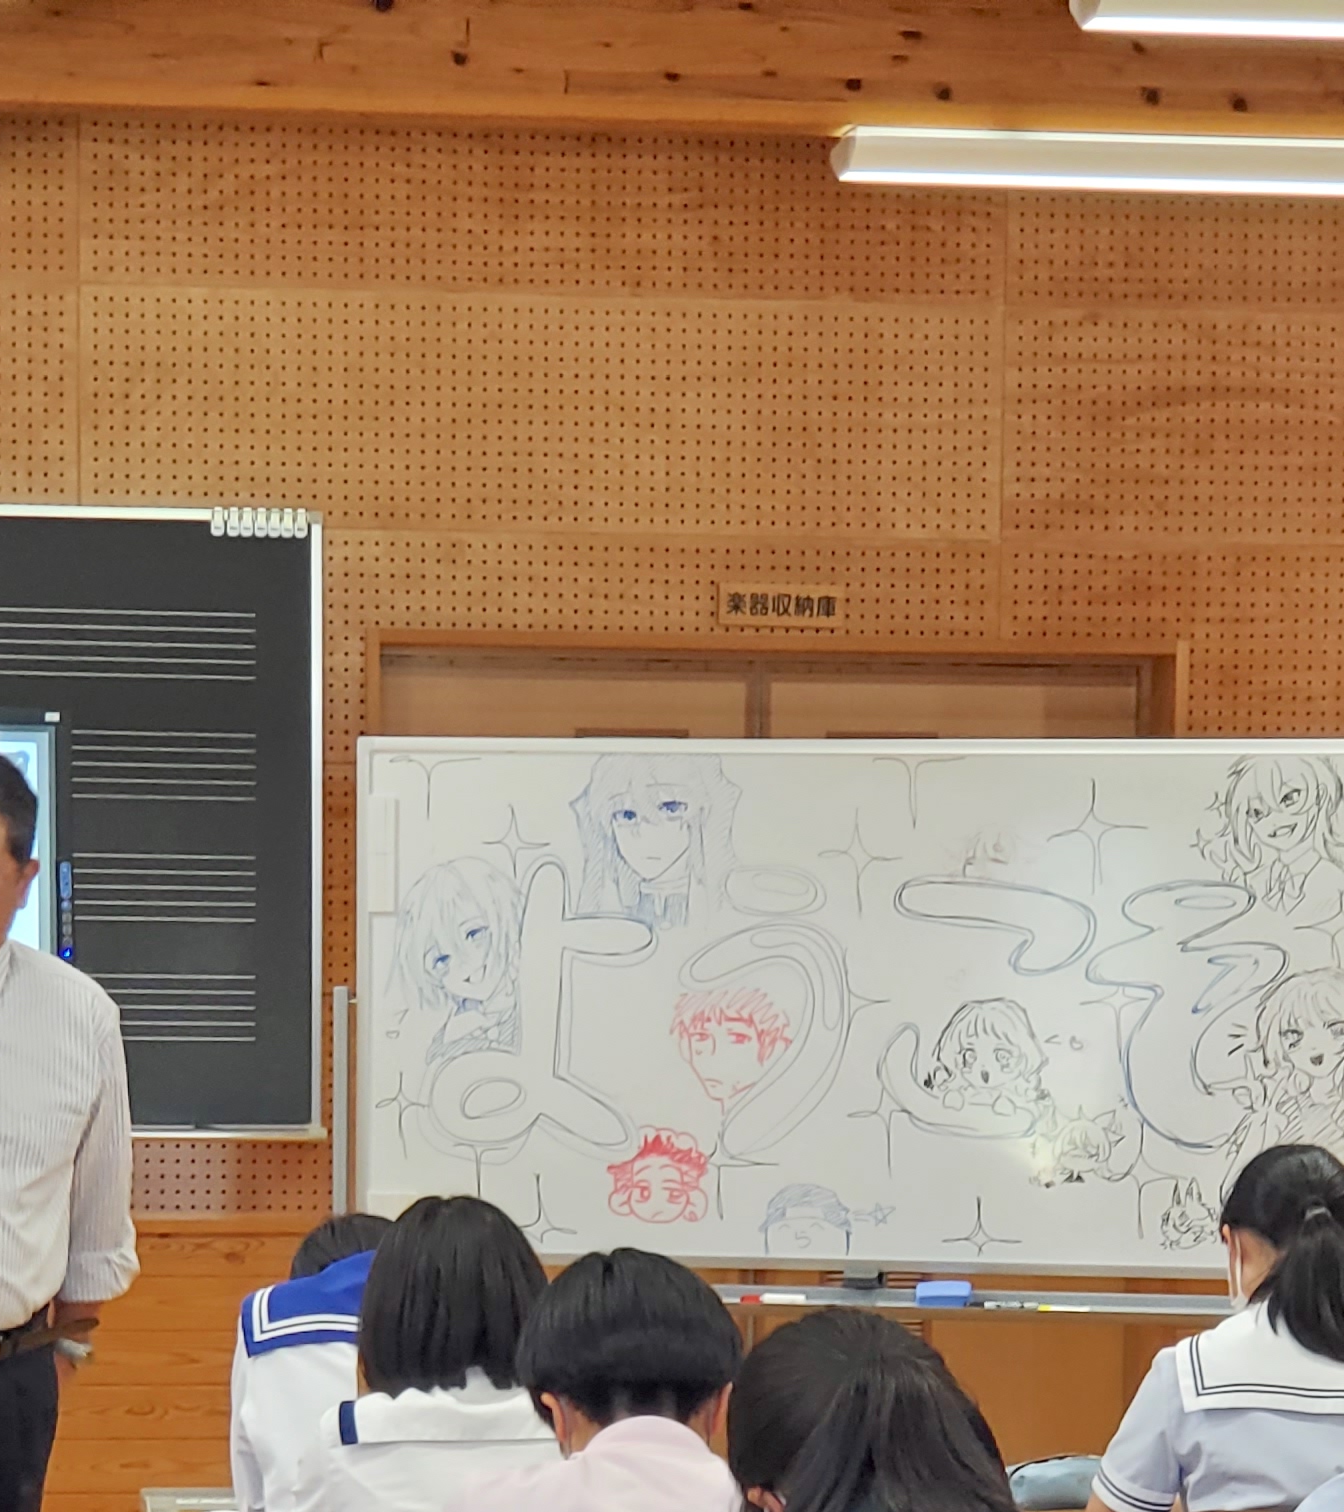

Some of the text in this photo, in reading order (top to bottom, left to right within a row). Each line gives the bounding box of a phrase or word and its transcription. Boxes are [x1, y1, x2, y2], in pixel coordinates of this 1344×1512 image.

[726, 592, 837, 618] 楽器収納庫
